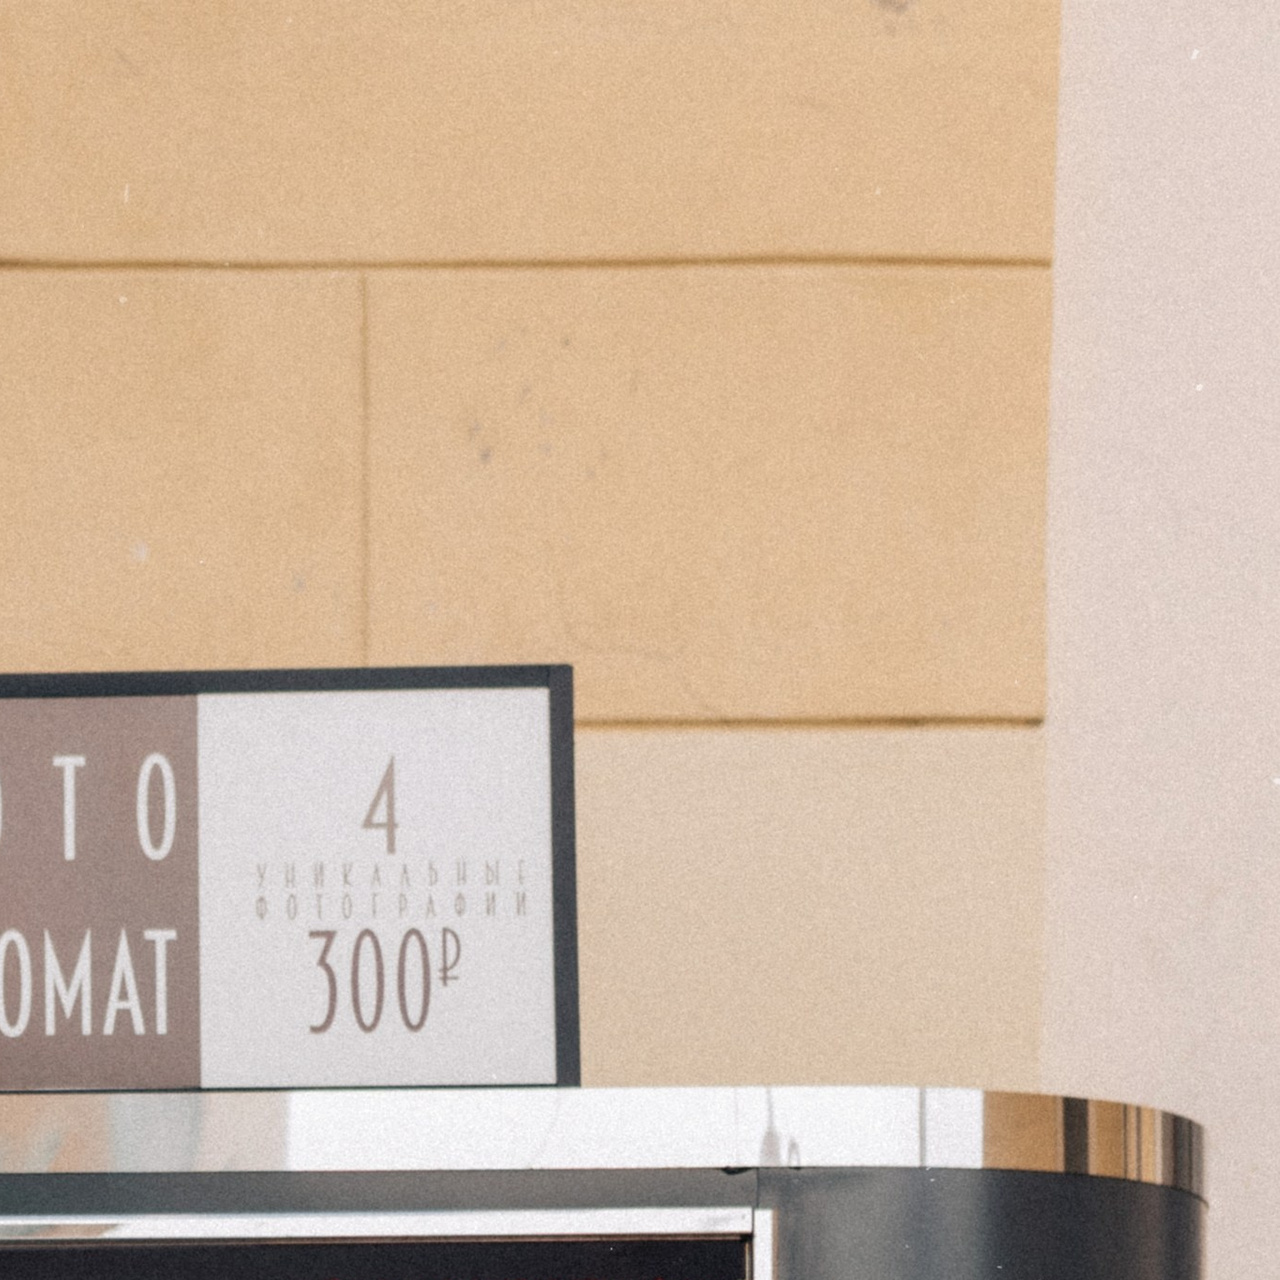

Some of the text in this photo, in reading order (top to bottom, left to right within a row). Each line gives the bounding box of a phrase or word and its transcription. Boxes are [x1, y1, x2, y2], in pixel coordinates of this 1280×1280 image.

[361, 754, 399, 855] 4
[255, 858, 526, 888] УНИКАЛЬНЫЕ
[255, 892, 528, 920] ФОТОГРАФИИ
